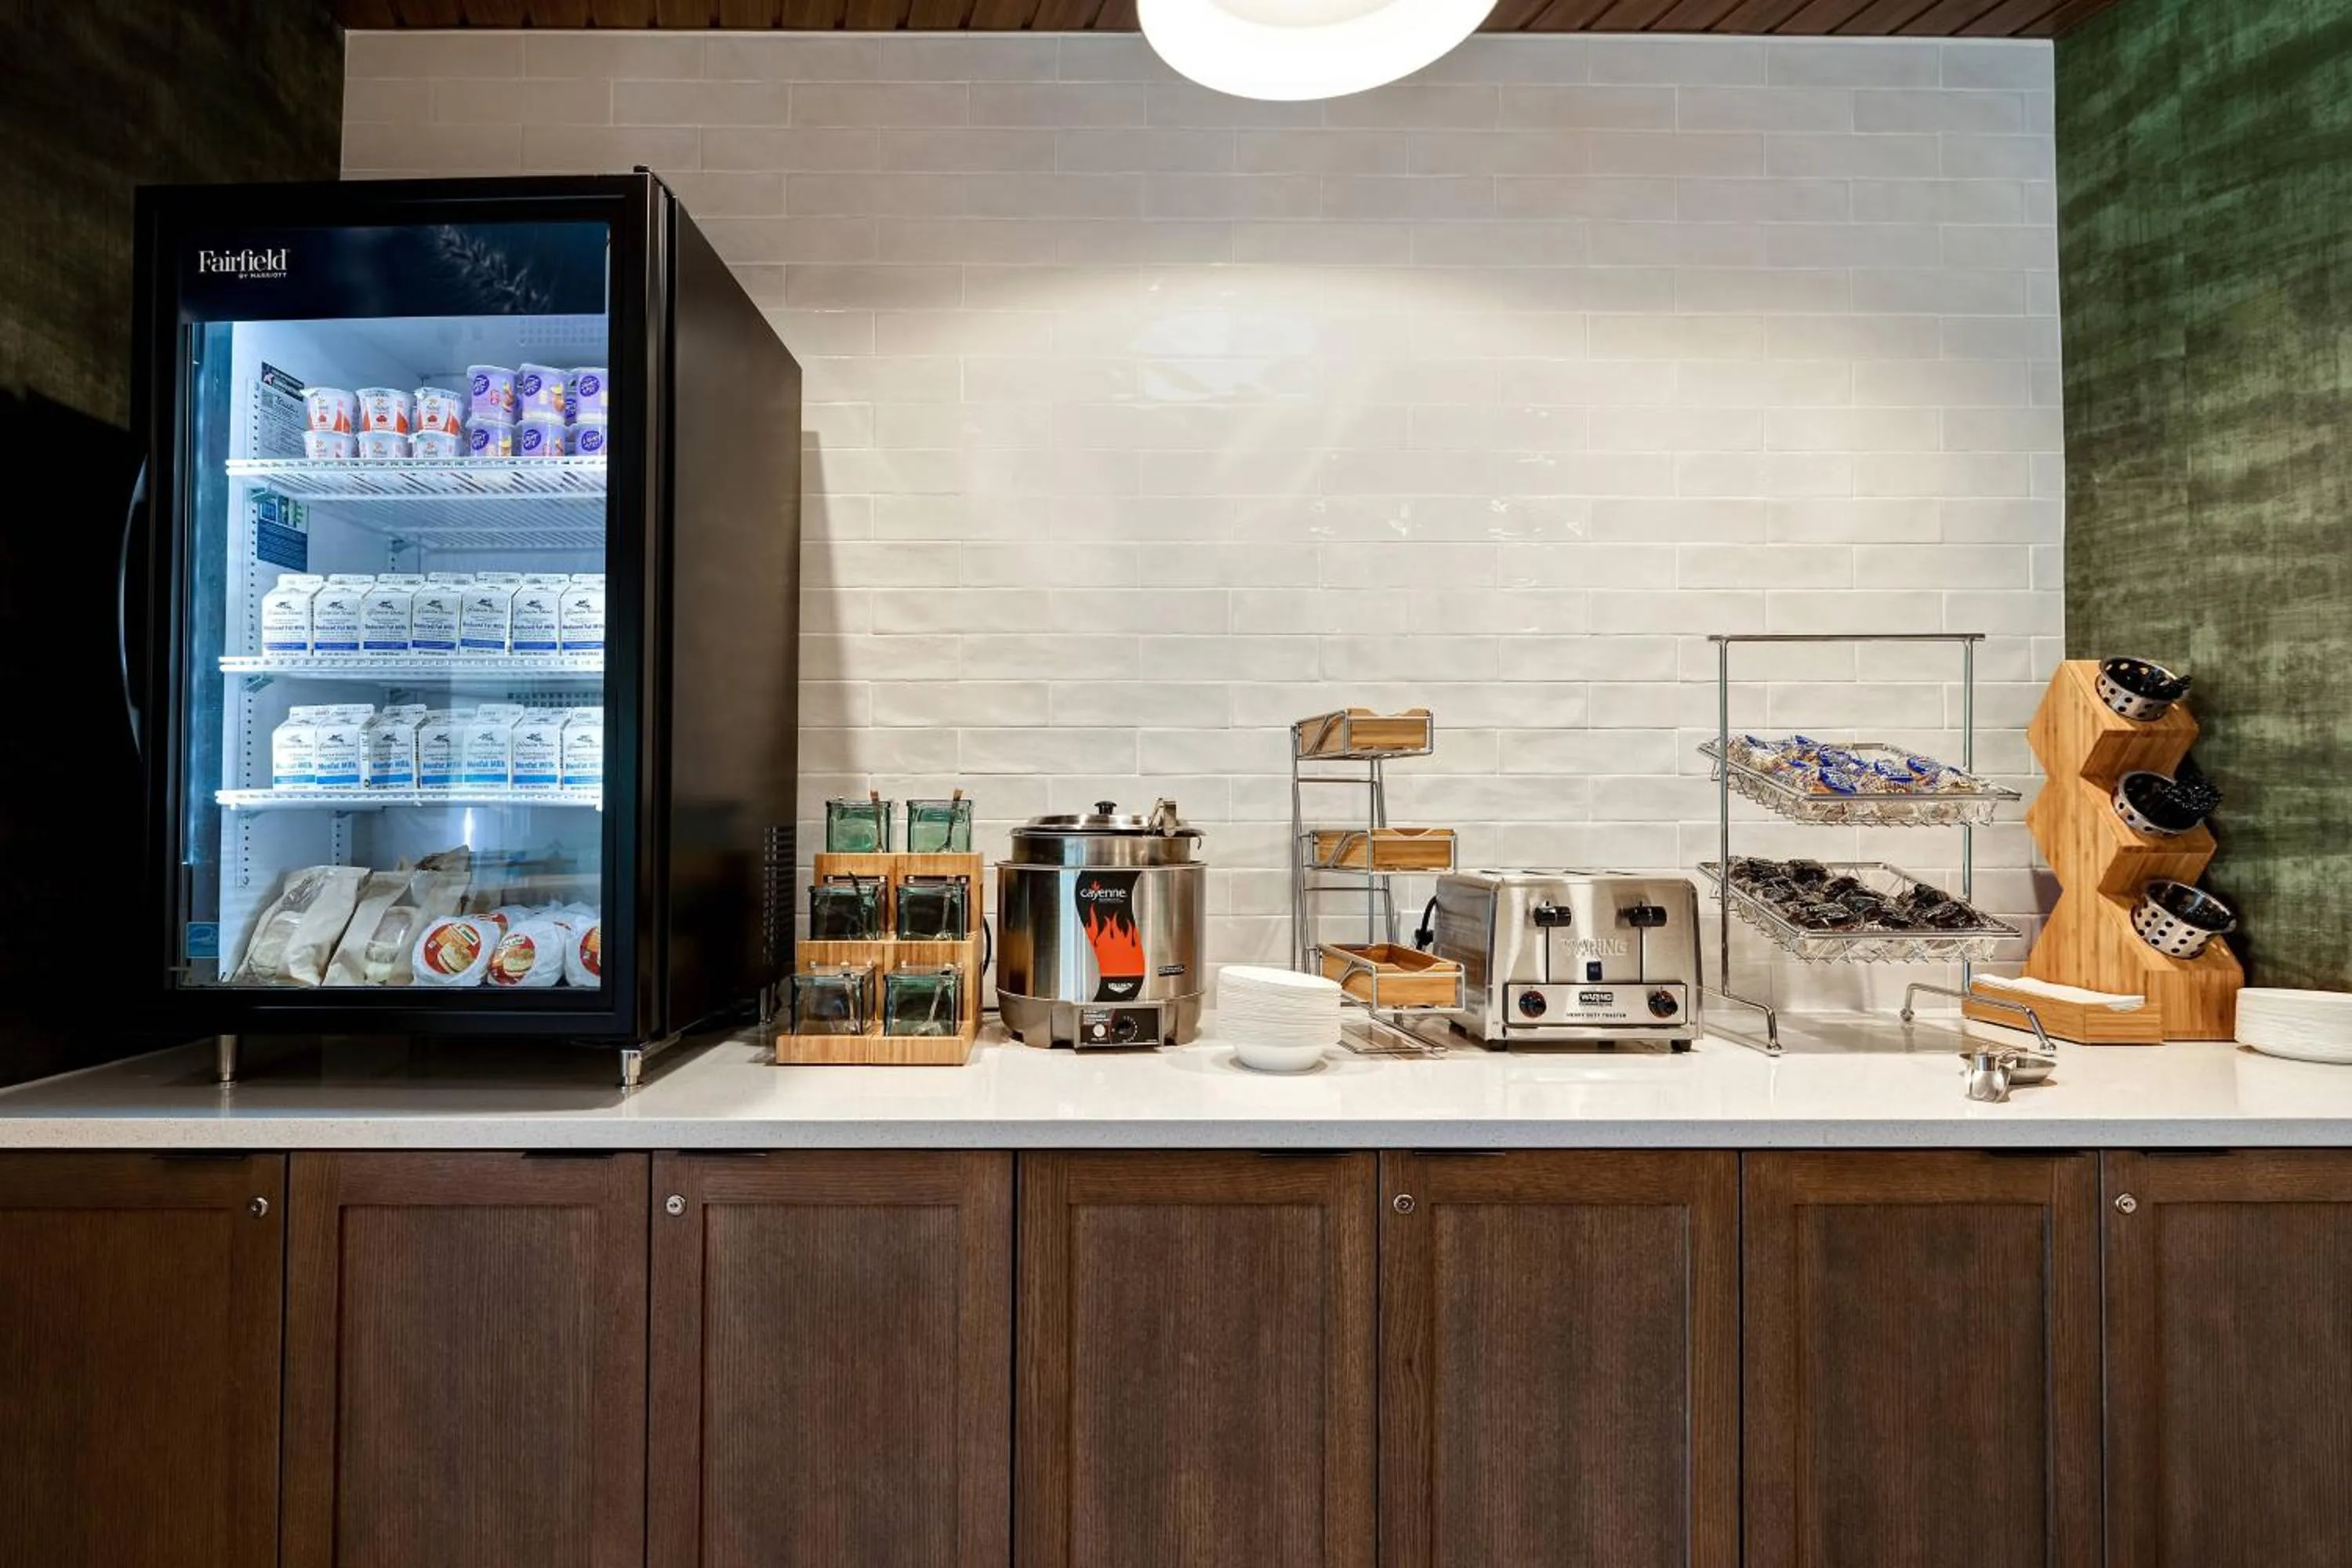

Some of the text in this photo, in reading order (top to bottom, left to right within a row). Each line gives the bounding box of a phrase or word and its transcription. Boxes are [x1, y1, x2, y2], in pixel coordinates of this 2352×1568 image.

[198, 249, 287, 272] Fairfield
[1080, 887, 1127, 901] cayenne
[1563, 938, 1629, 958] WARING
